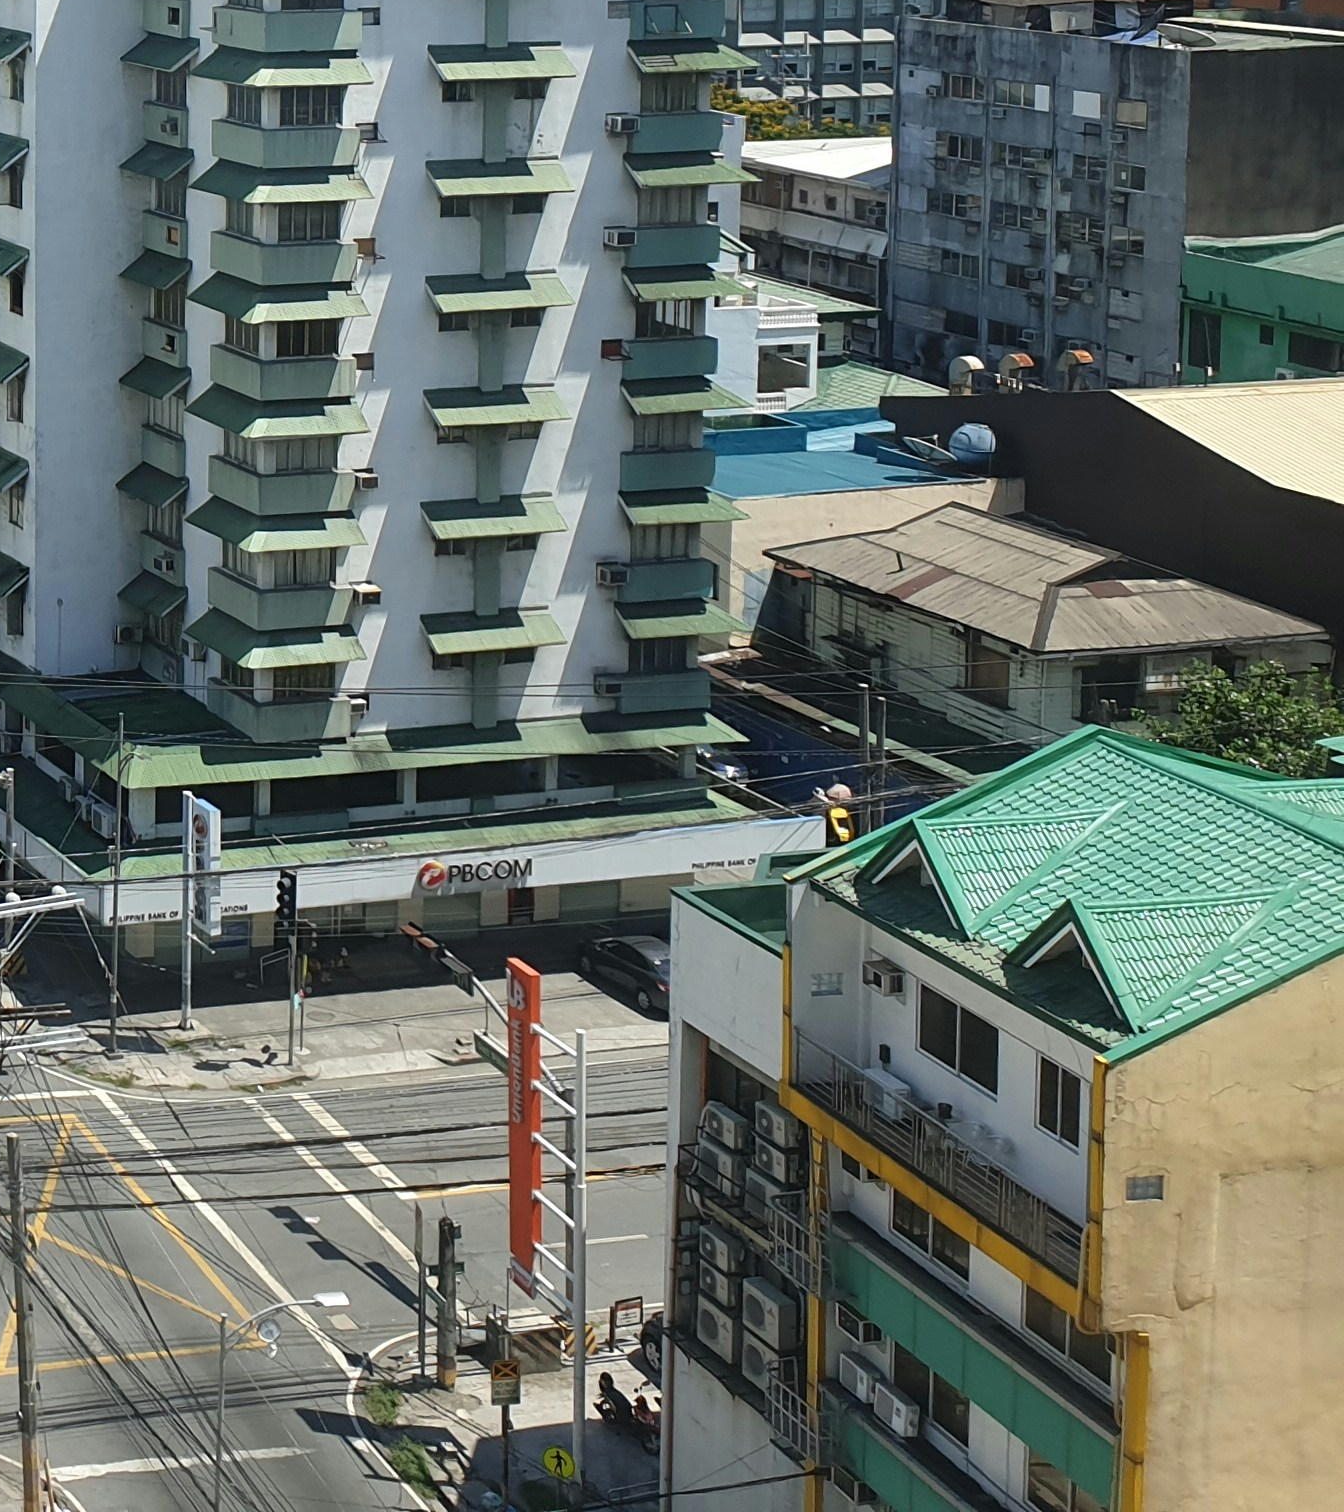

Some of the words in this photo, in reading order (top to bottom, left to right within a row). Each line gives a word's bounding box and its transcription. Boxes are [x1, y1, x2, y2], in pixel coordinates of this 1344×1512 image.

[728, 859, 745, 867] BANK
[747, 857, 756, 865] OF
[448, 858, 533, 884] PBCOM
[148, 912, 166, 921] BANK
[169, 910, 179, 918] OF
